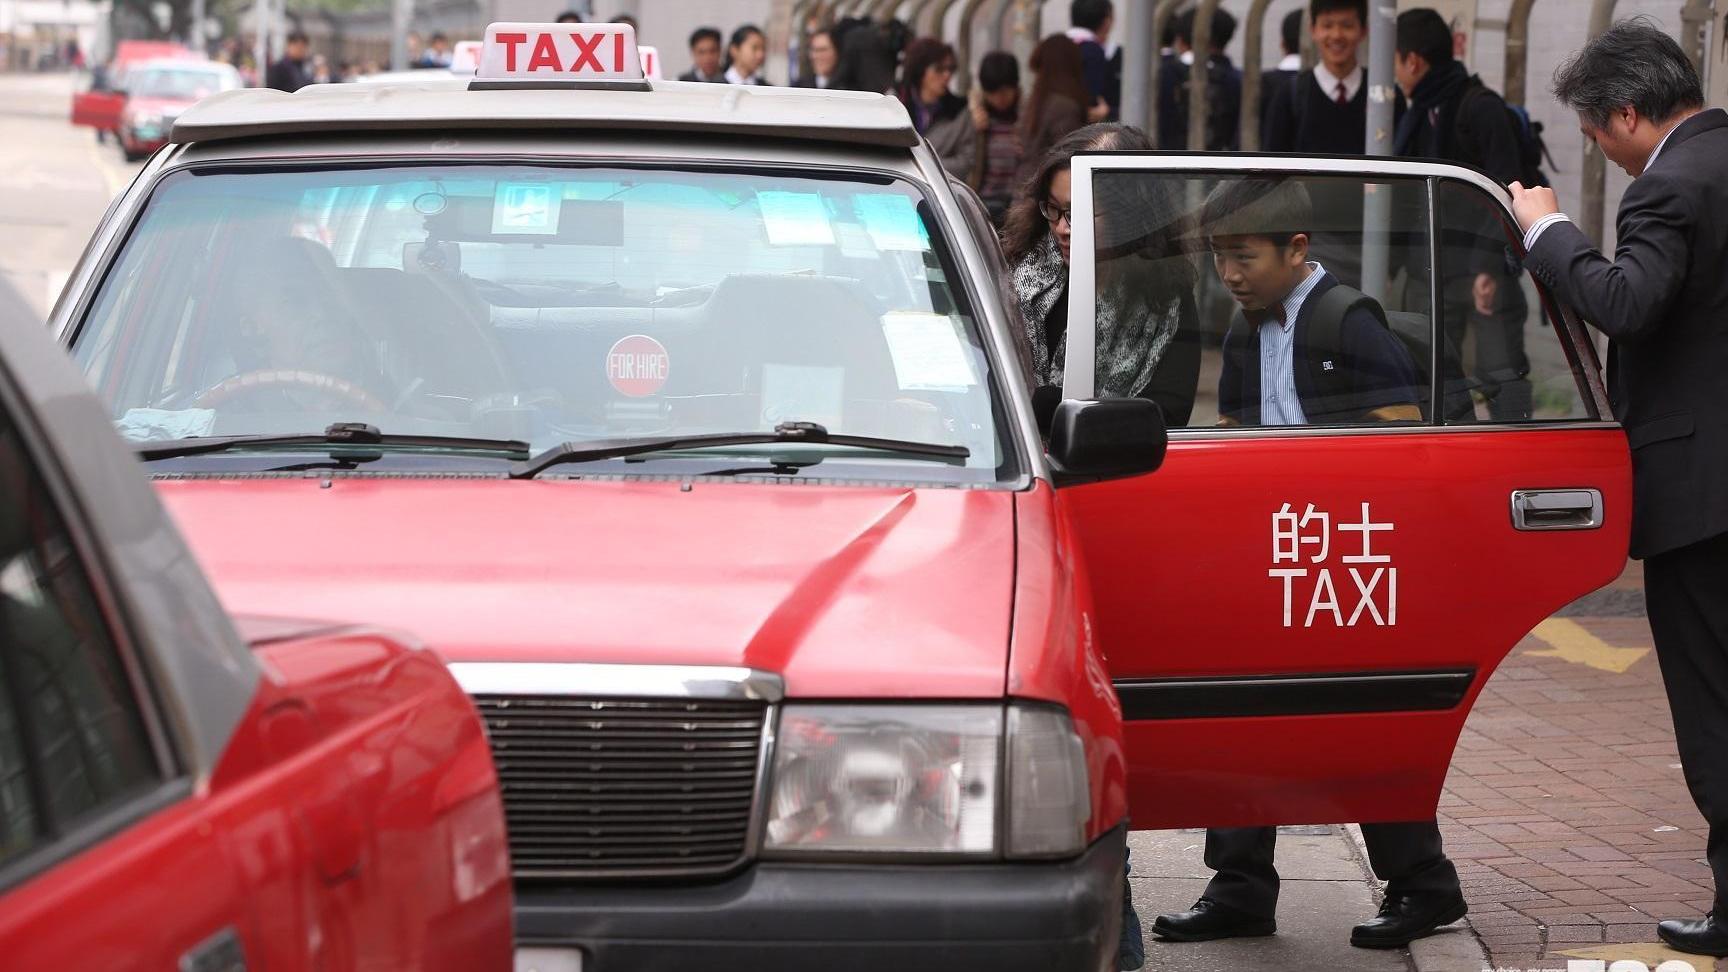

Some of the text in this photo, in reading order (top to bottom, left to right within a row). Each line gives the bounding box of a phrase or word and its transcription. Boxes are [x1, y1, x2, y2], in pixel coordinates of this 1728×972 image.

[495, 33, 624, 73] TAXI
[610, 353, 665, 379] FOR HIRE
[1272, 502, 1394, 564] 的士
[1268, 568, 1397, 627] TAXI
